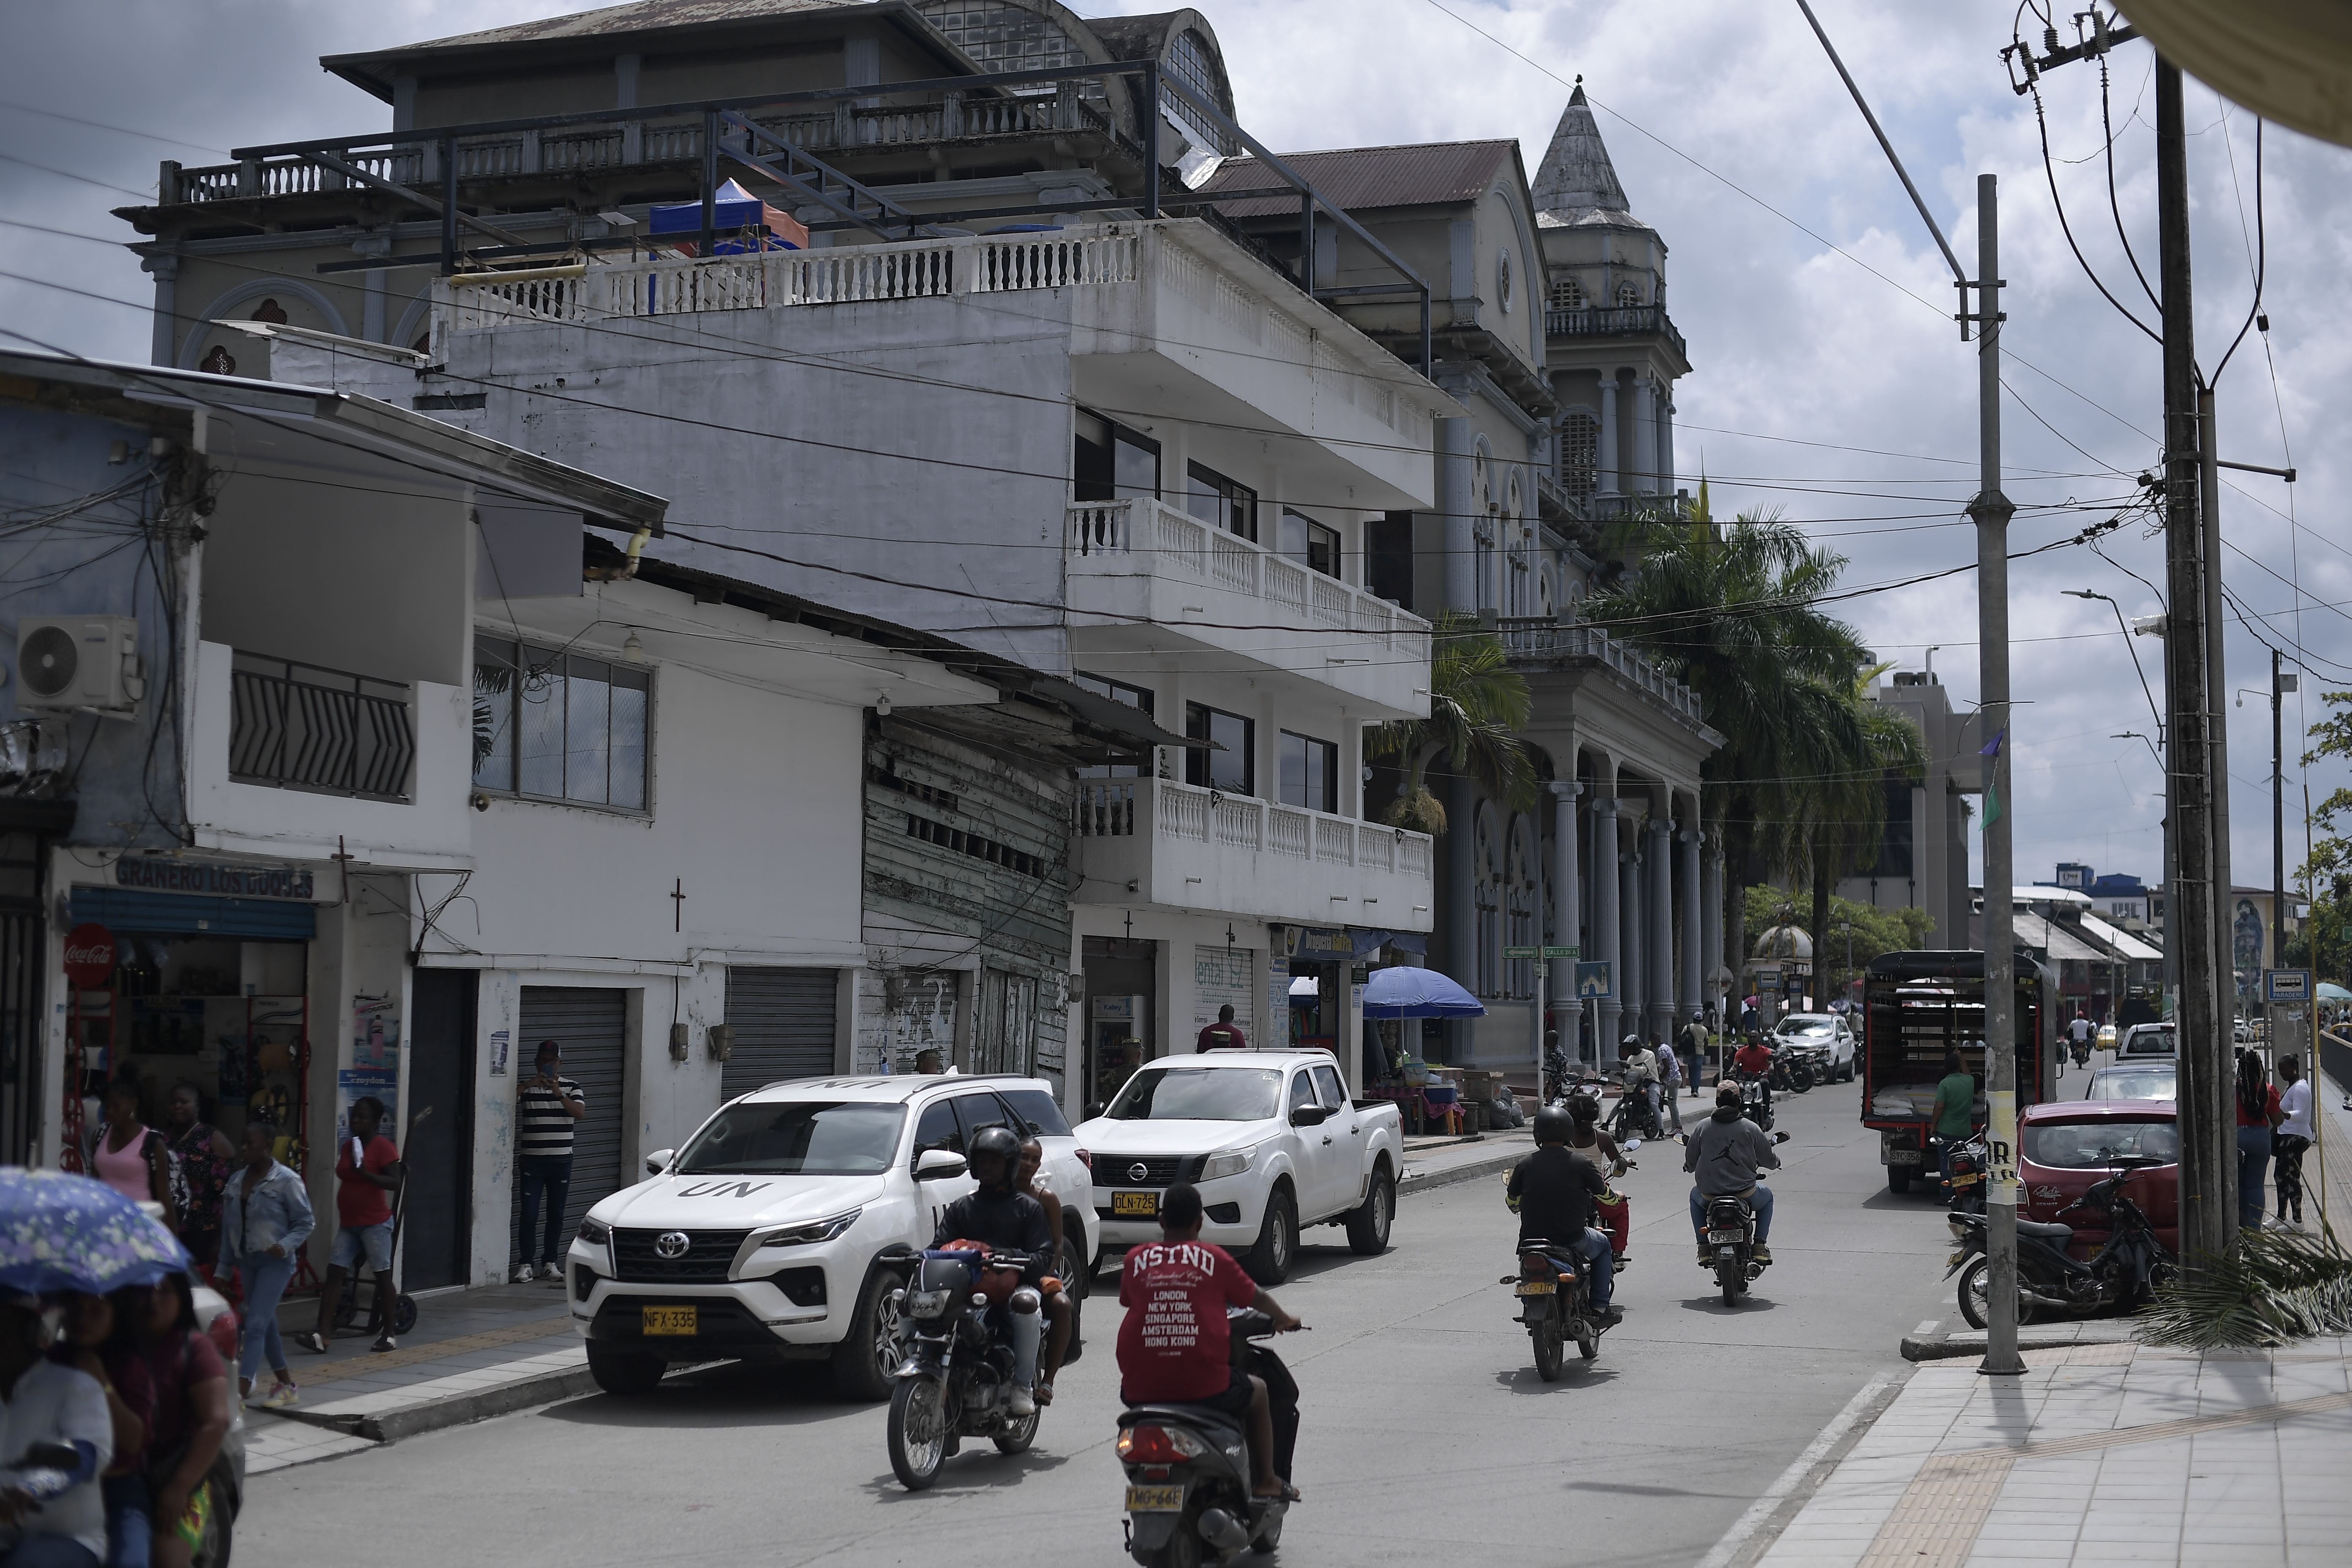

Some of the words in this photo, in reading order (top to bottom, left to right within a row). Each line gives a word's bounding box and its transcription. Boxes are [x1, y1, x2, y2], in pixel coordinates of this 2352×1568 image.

[117, 859, 204, 891] GRANERO
[210, 865, 242, 894] LOS
[248, 870, 313, 899] DUQUES
[1306, 931, 1332, 953] Droguería
[1332, 934, 1342, 952] San
[65, 945, 112, 963] Coca-Cola
[350, 1077, 386, 1086] croydon
[678, 1181, 774, 1198] UN
[1132, 1244, 1215, 1277] NSTND
[1154, 1290, 1188, 1301] LONDON
[1148, 1302, 1168, 1313] NEW
[1168, 1301, 1192, 1312] YORK
[1145, 1313, 1195, 1324] SINGAPORE
[1141, 1324, 1200, 1336] AMSTERDAM
[1144, 1336, 1168, 1348] HONG
[1170, 1336, 1196, 1347] KONG
